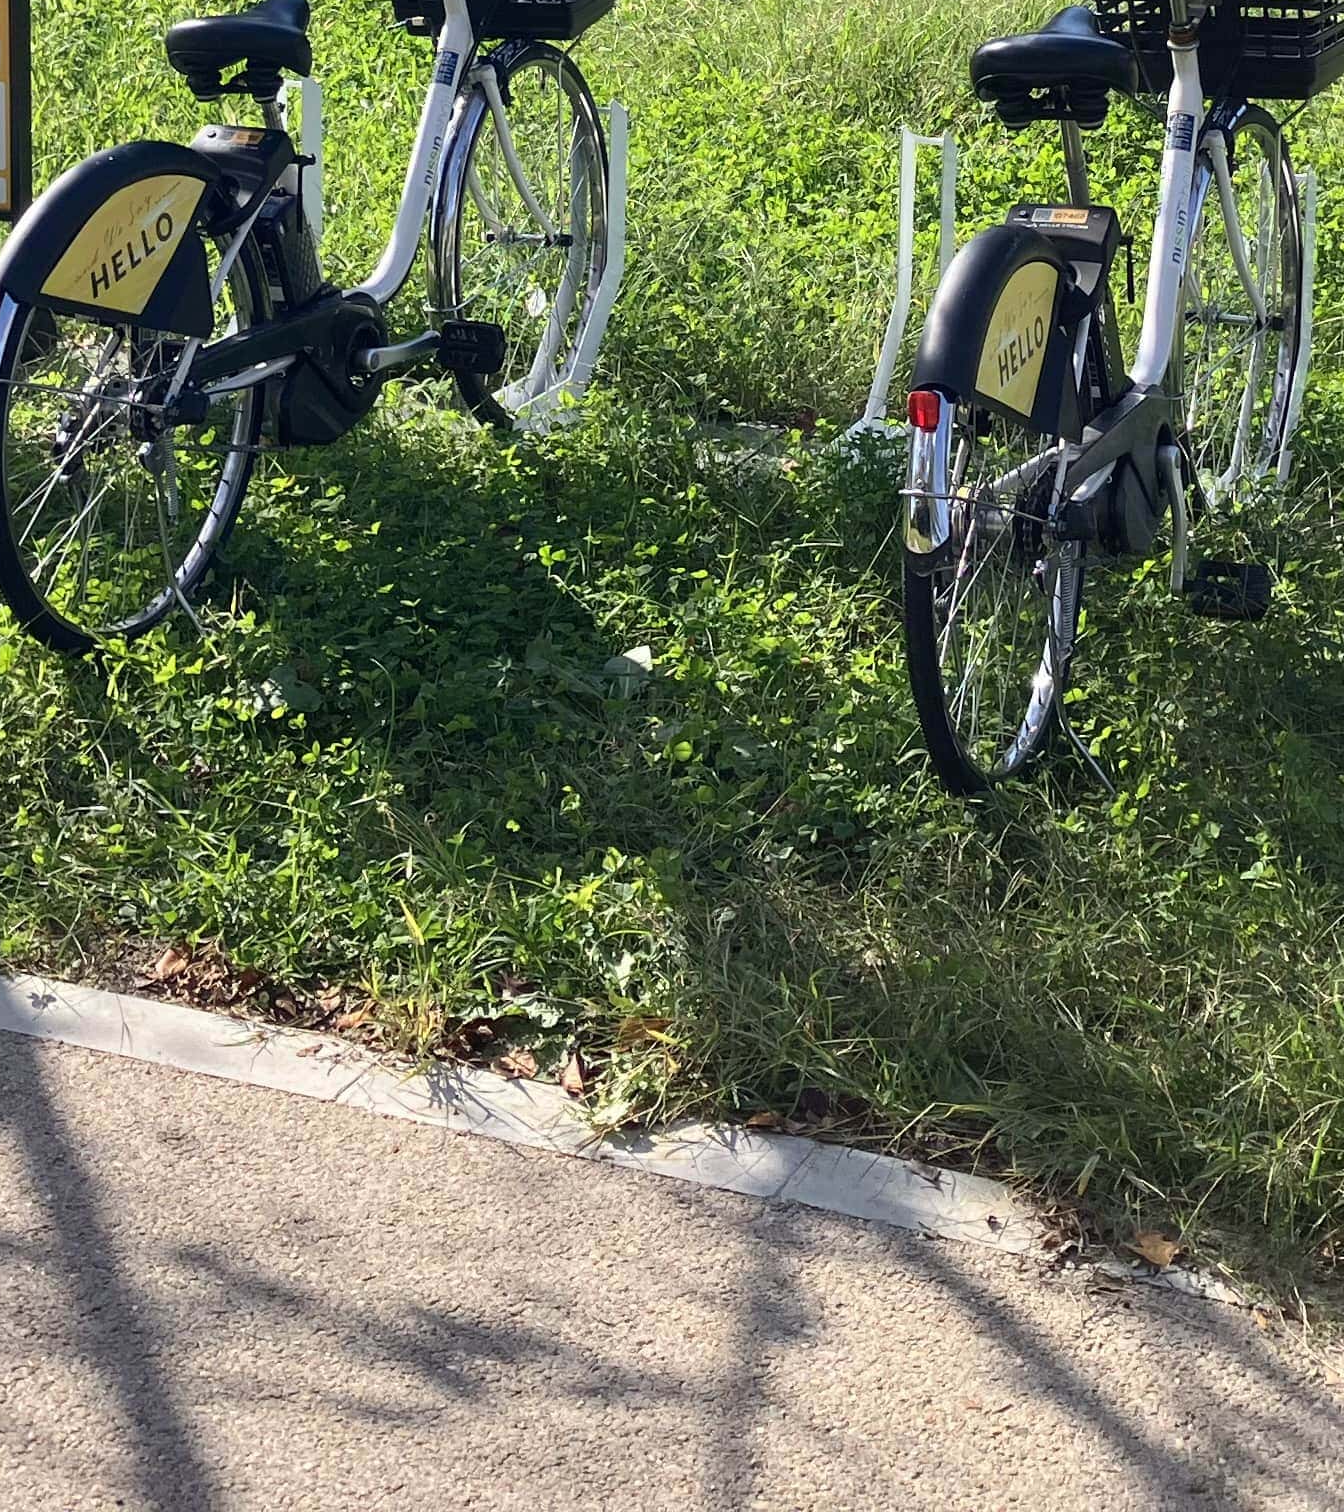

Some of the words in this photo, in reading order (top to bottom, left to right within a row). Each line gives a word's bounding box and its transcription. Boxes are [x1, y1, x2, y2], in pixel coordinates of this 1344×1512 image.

[424, 136, 442, 186] nissin
[90, 212, 173, 299] HELLO
[1172, 209, 1188, 264] nissin
[998, 315, 1044, 387] HELLO
